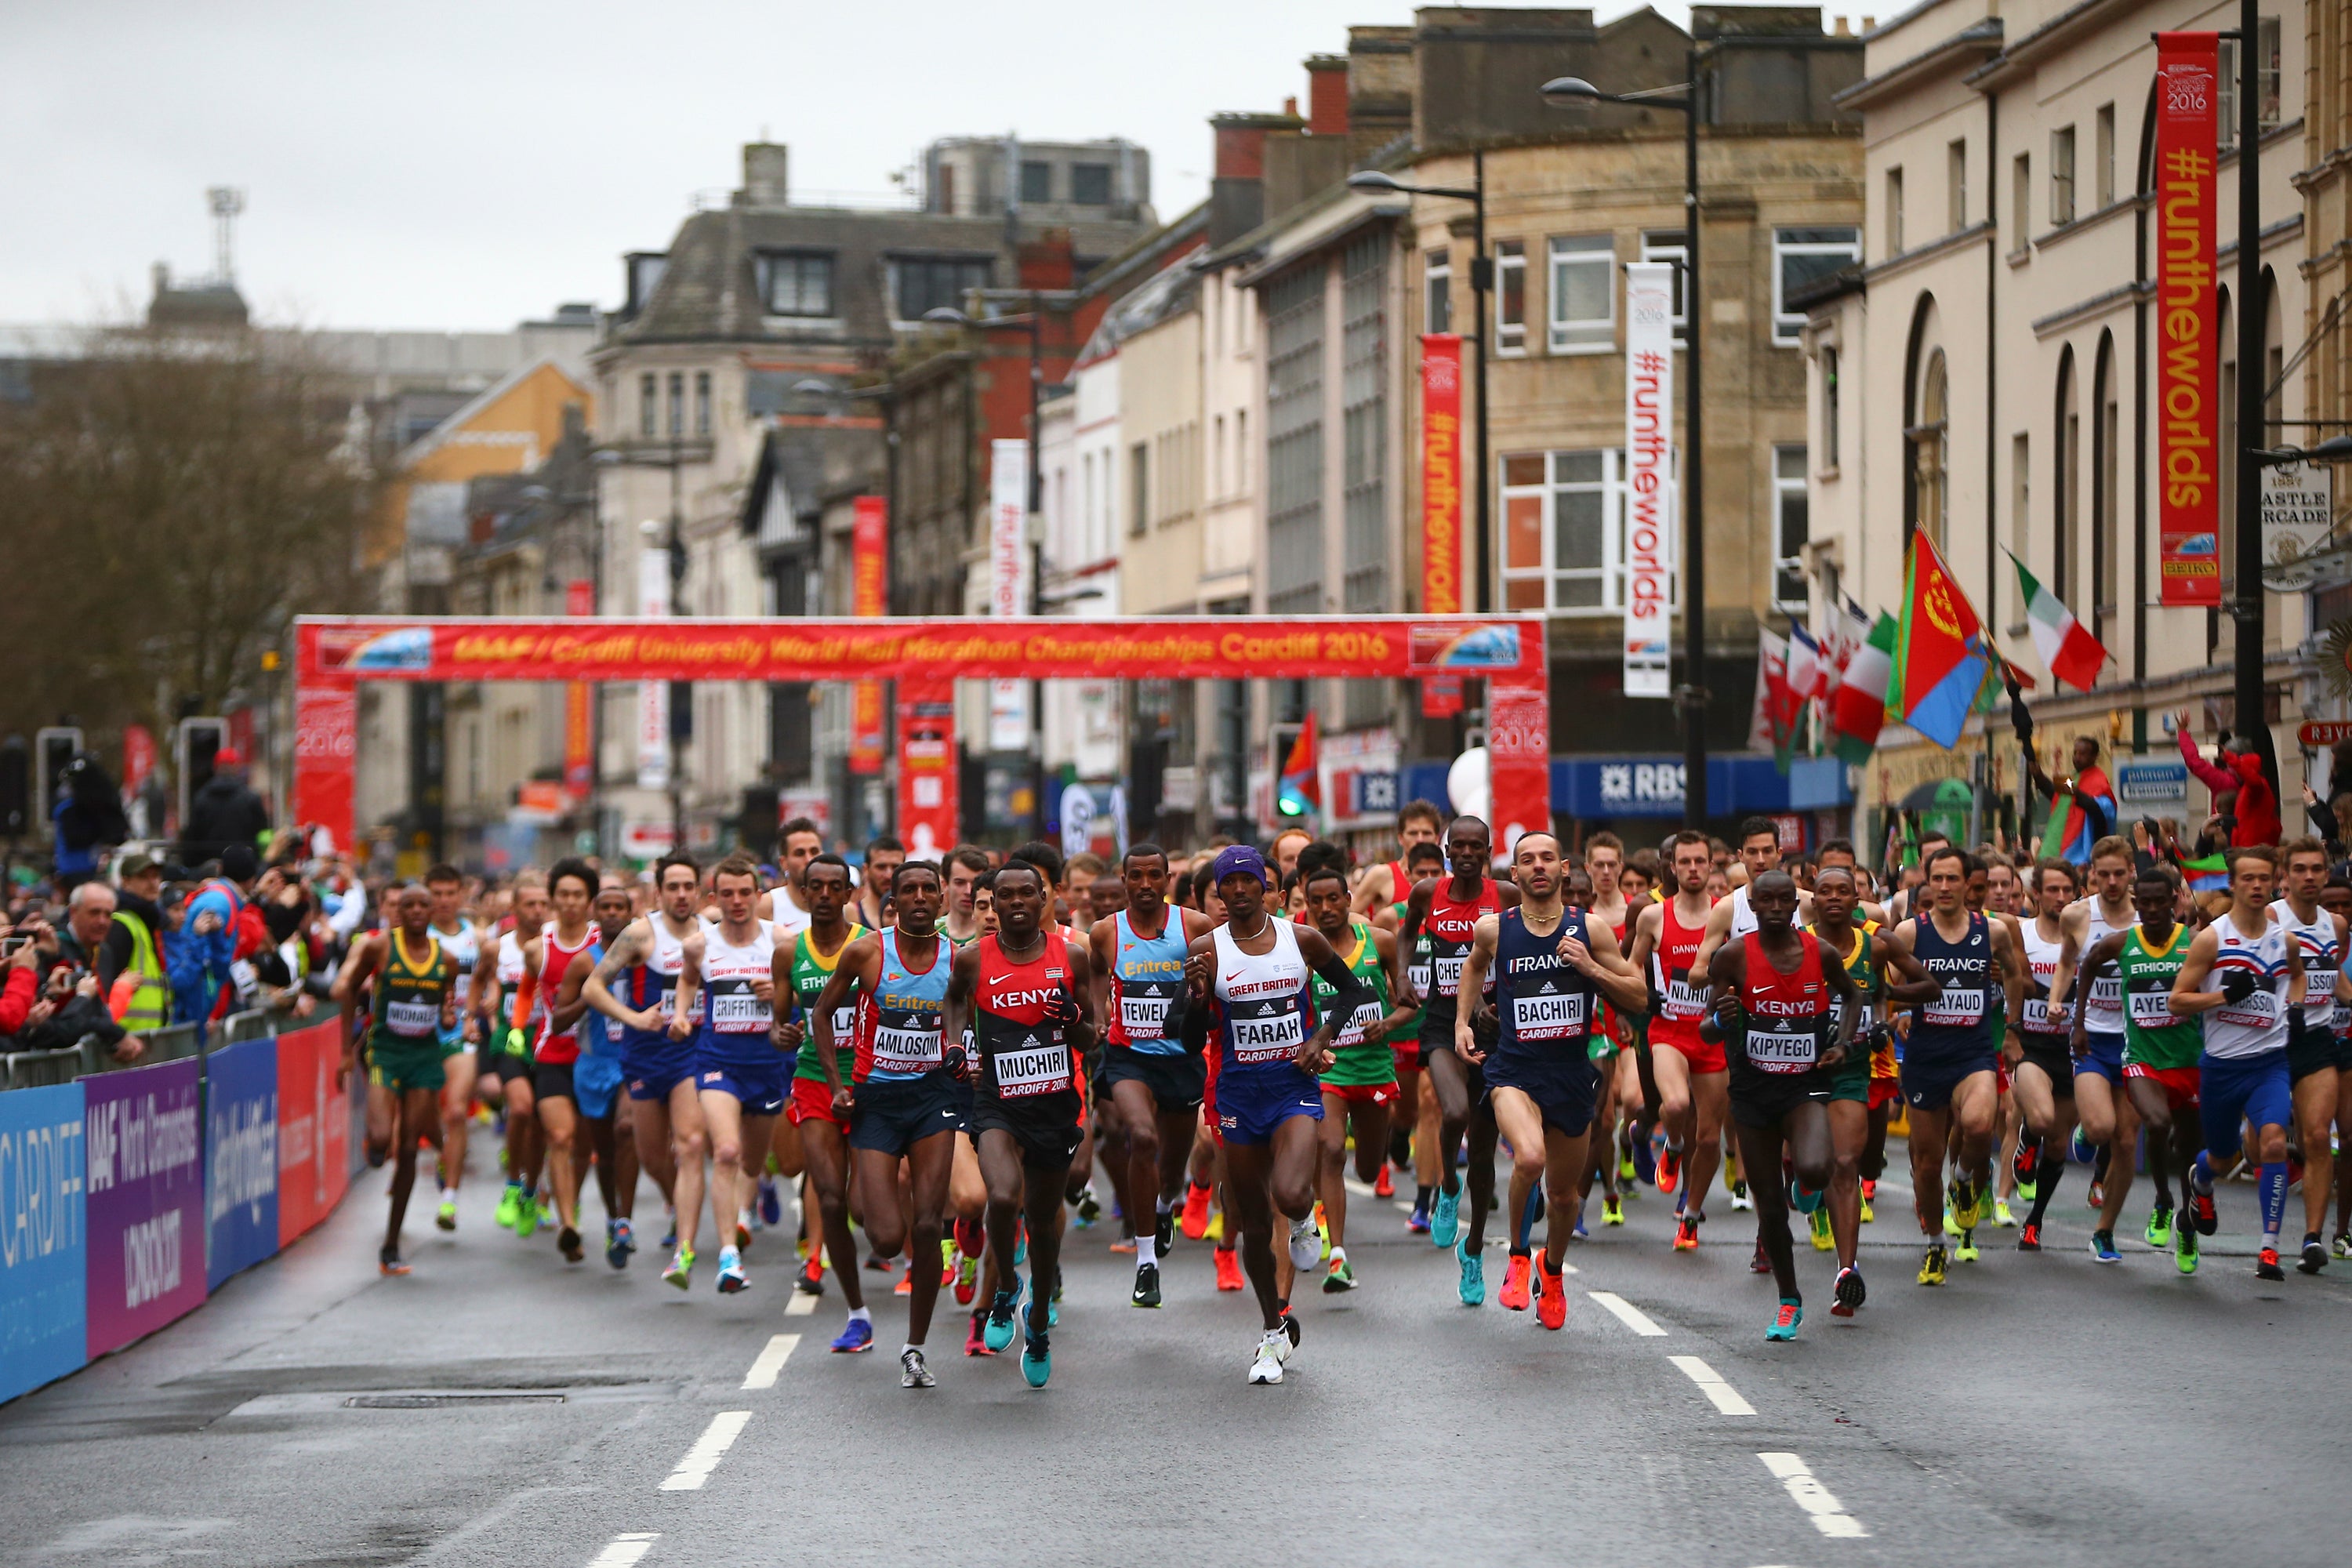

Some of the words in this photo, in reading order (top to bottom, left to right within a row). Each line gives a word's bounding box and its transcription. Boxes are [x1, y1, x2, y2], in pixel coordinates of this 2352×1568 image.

[2168, 85, 2206, 93] CARDIFF
[2167, 93, 2207, 111] 2016
[2165, 147, 2211, 509] #runtheworlds
[1633, 349, 1668, 619] #runtheworlds
[2262, 491, 2326, 506] ASTLE
[2262, 510, 2328, 525] RCADE
[2165, 562, 2215, 574] SEIKO
[551, 634, 637, 662] Cardiff
[639, 634, 764, 665] University
[770, 635, 849, 661] World
[902, 635, 1019, 662] Marathon
[1025, 634, 1214, 666] Championships
[1220, 633, 1321, 661] Cardiff
[1324, 632, 1388, 660] 2016
[296, 728, 357, 757] 2016
[1491, 727, 1548, 754] 2016
[1438, 920, 1475, 931] KENY
[1672, 944, 1698, 955] DANM
[739, 967, 771, 975] BRITAIN
[1125, 960, 1181, 976] Eritrea
[1515, 955, 1570, 973] FRANC
[1928, 958, 1987, 972] FRANCE
[1228, 982, 1260, 998] GREAT
[1261, 977, 1299, 992] BRITAIN
[1671, 984, 1708, 1003] NIJHU
[715, 1000, 769, 1018] GRIFFITHS
[885, 993, 944, 1011] Eritrea
[1518, 999, 1580, 1023] BACHIRI
[1755, 1000, 1814, 1015] KENYA
[1123, 1003, 1171, 1022] TEWEL
[1926, 1014, 1964, 1025] CARDIFF
[715, 1022, 751, 1033] CARDIFF
[1124, 1027, 1163, 1038] CARDIFF
[1236, 1018, 1299, 1044] FARAH
[1519, 1027, 1564, 1040] CARDIFF
[1566, 1025, 1581, 1036] 2016
[876, 1031, 938, 1056] AMLOSOM
[1750, 1036, 1812, 1057] KIPYEGO
[1237, 1048, 1283, 1062] CARDIFF
[873, 1057, 918, 1072] CARDIFF
[999, 1050, 1065, 1080] MUCHIRI
[1751, 1060, 1792, 1072] CARDIFF
[1793, 1063, 1811, 1073] 2016
[1003, 1080, 1050, 1097] CARDIFF
[1051, 1077, 1069, 1091] 2016
[87, 1099, 118, 1195] IAAF
[118, 1096, 149, 1183] World
[1, 1120, 82, 1269] CARDIFF
[2270, 1174, 2285, 1218] ICELAND
